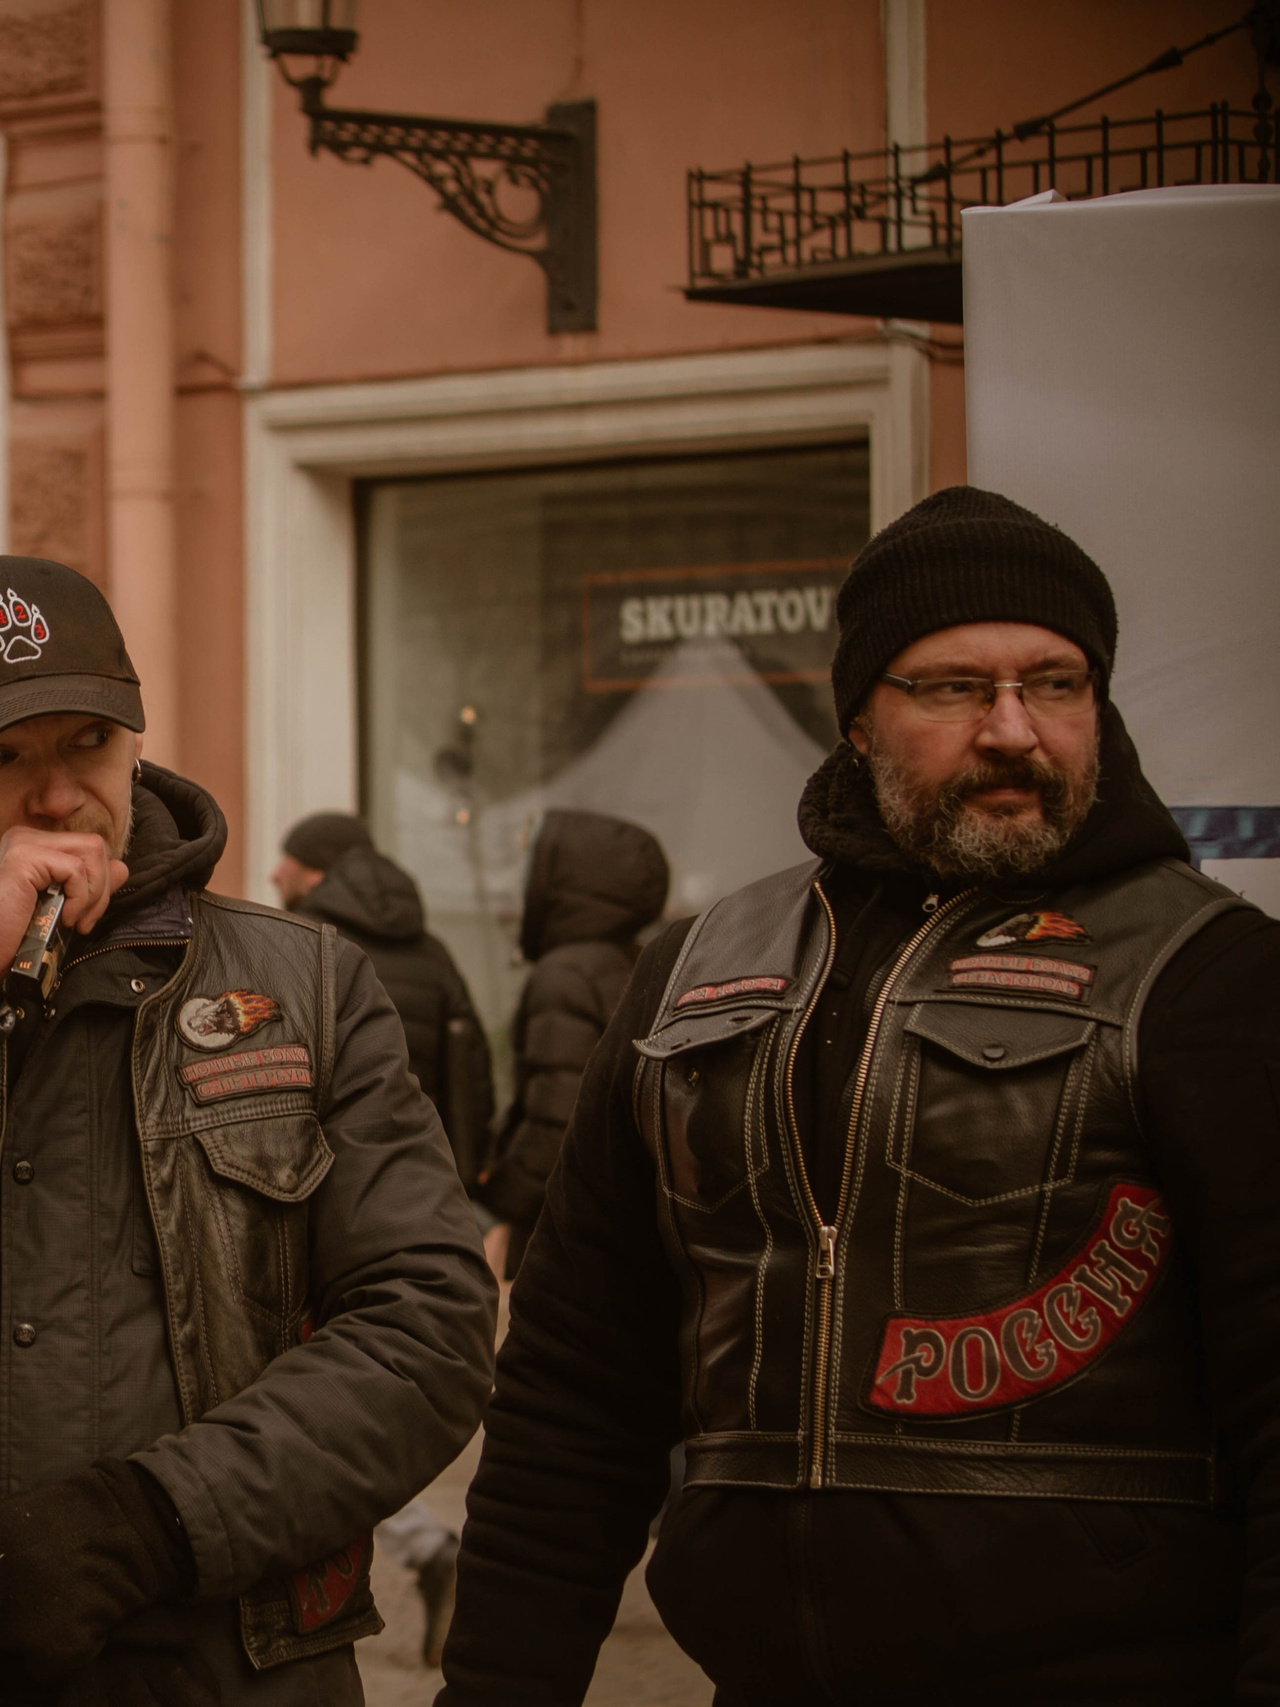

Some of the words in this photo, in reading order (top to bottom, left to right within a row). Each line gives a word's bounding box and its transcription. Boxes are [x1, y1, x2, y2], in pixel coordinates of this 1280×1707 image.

[14, 604, 27, 620] 2
[35, 624, 45, 640] 3
[621, 587, 834, 644] SKURATOV
[953, 970, 1080, 996] СЕВАСТОПОЛЬ
[183, 1051, 258, 1081] НОЧНЫЕ
[876, 1196, 1169, 1404] РОССИЯ
